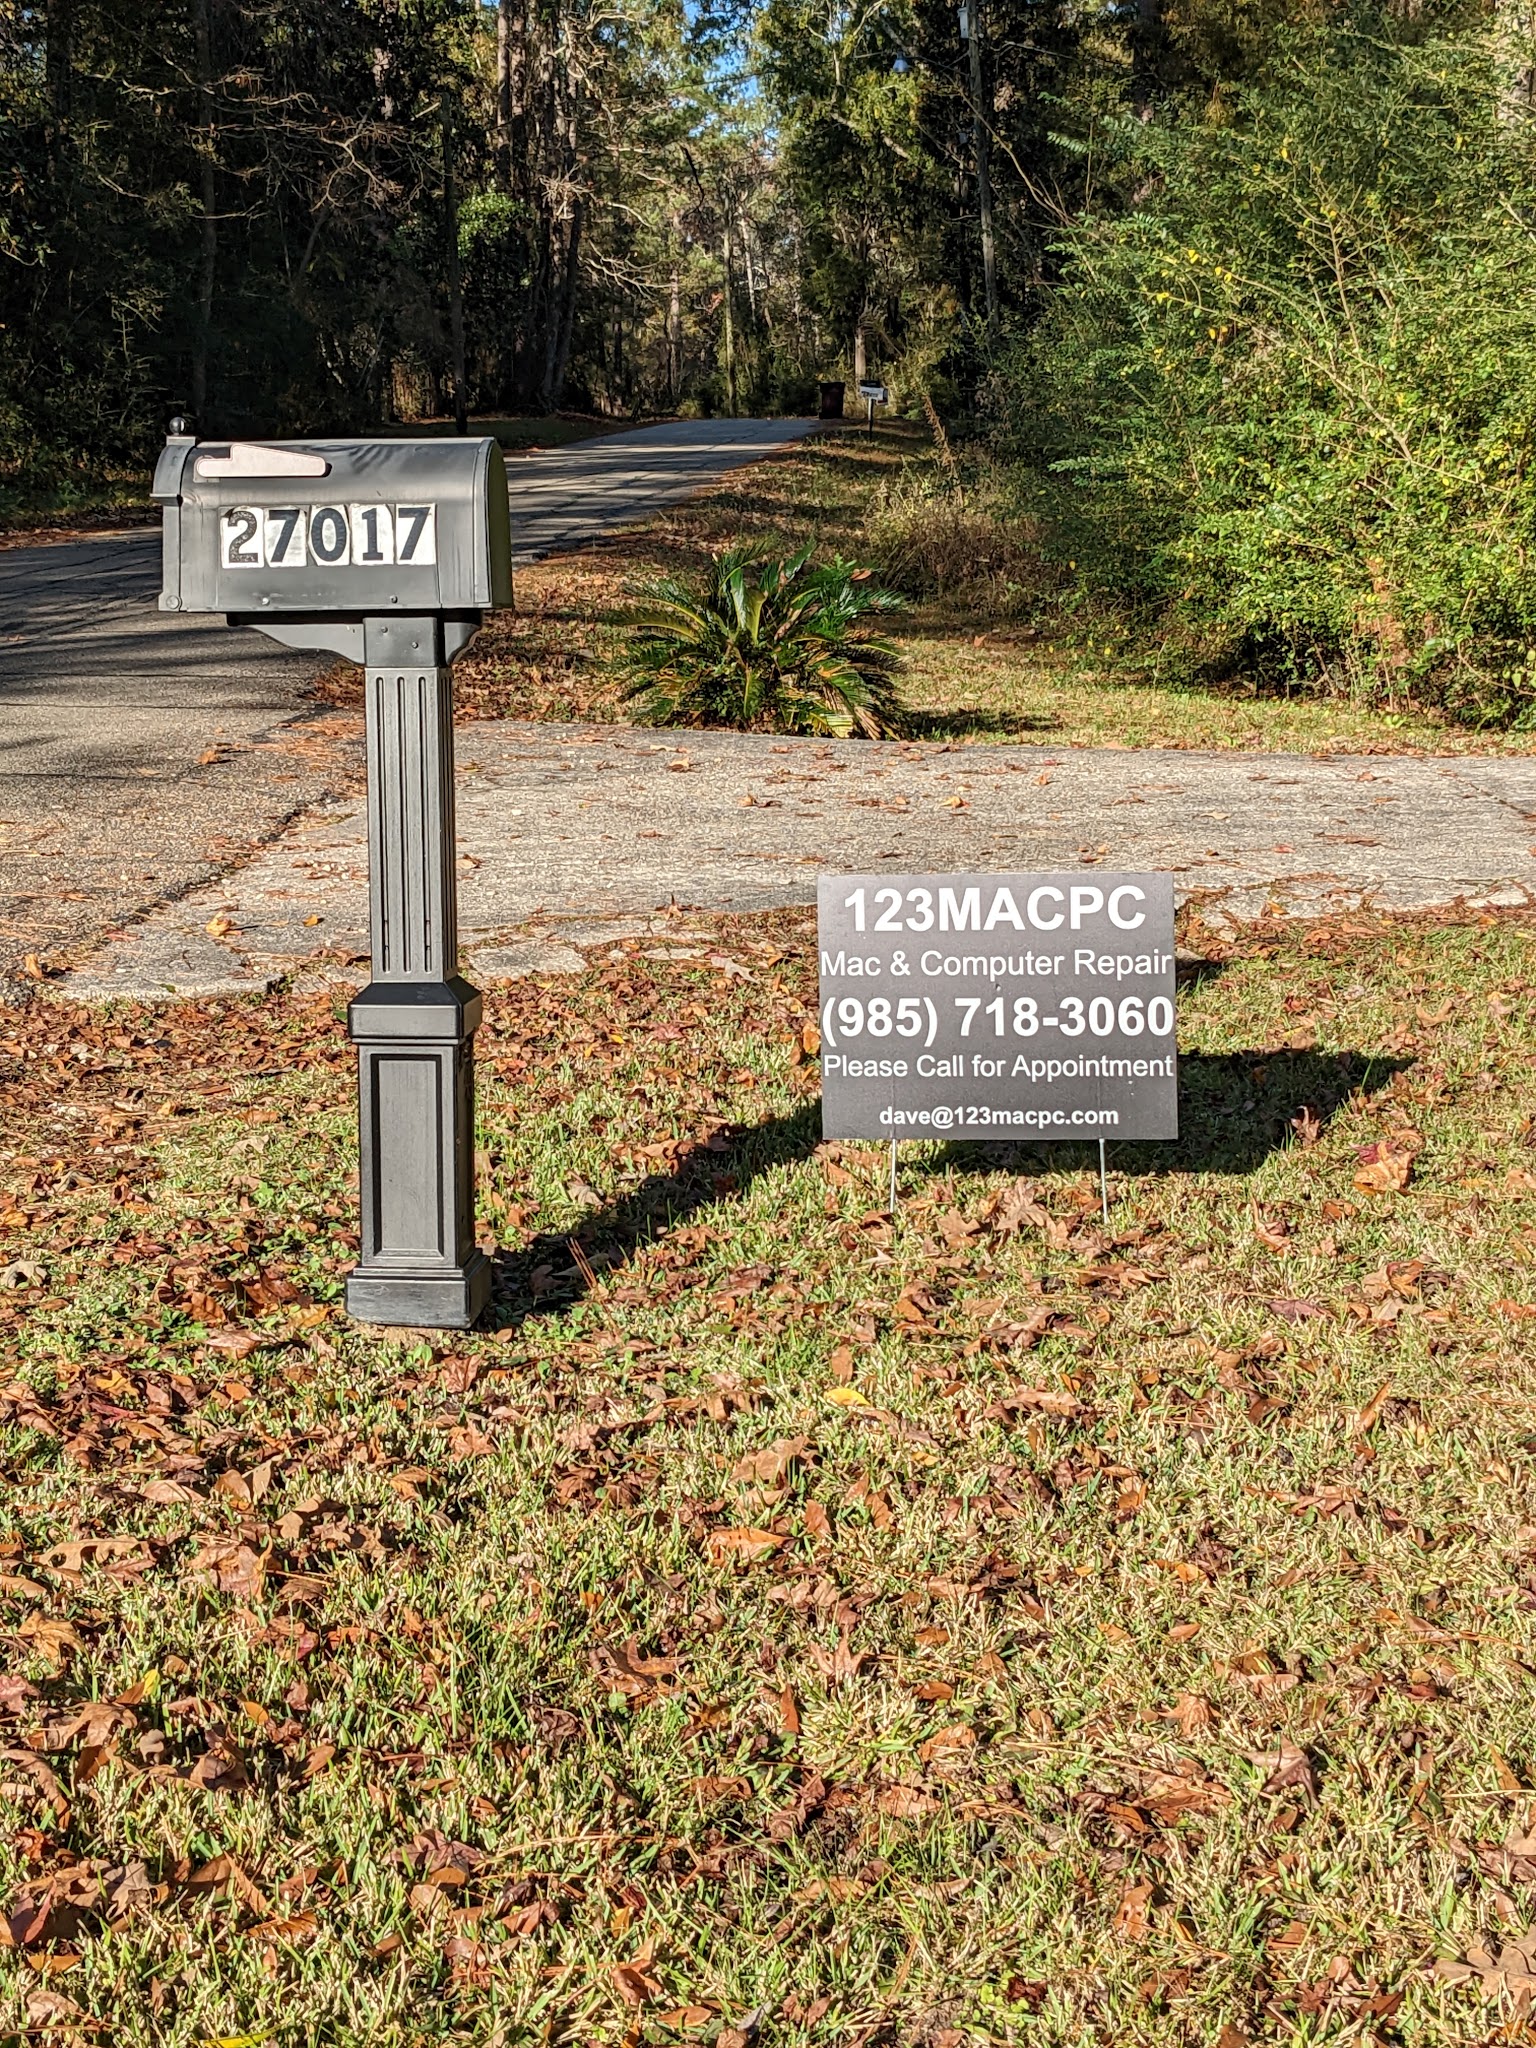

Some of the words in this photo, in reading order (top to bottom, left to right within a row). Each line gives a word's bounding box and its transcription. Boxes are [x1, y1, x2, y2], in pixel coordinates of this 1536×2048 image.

[227, 506, 432, 565] 27017
[844, 885, 1146, 932] 123MACPC
[821, 951, 881, 976] Mac
[890, 951, 911, 976] &
[920, 951, 1065, 981] Computer
[1074, 949, 1173, 980] Repair
[822, 997, 938, 1047] (985)
[954, 996, 1174, 1037] 718-3060
[823, 1055, 908, 1077] Please
[916, 1055, 964, 1077] Call
[972, 1055, 1006, 1077] for
[1011, 1054, 1174, 1082] Appointment
[879, 1106, 1119, 1130] dave@123macpc.com
